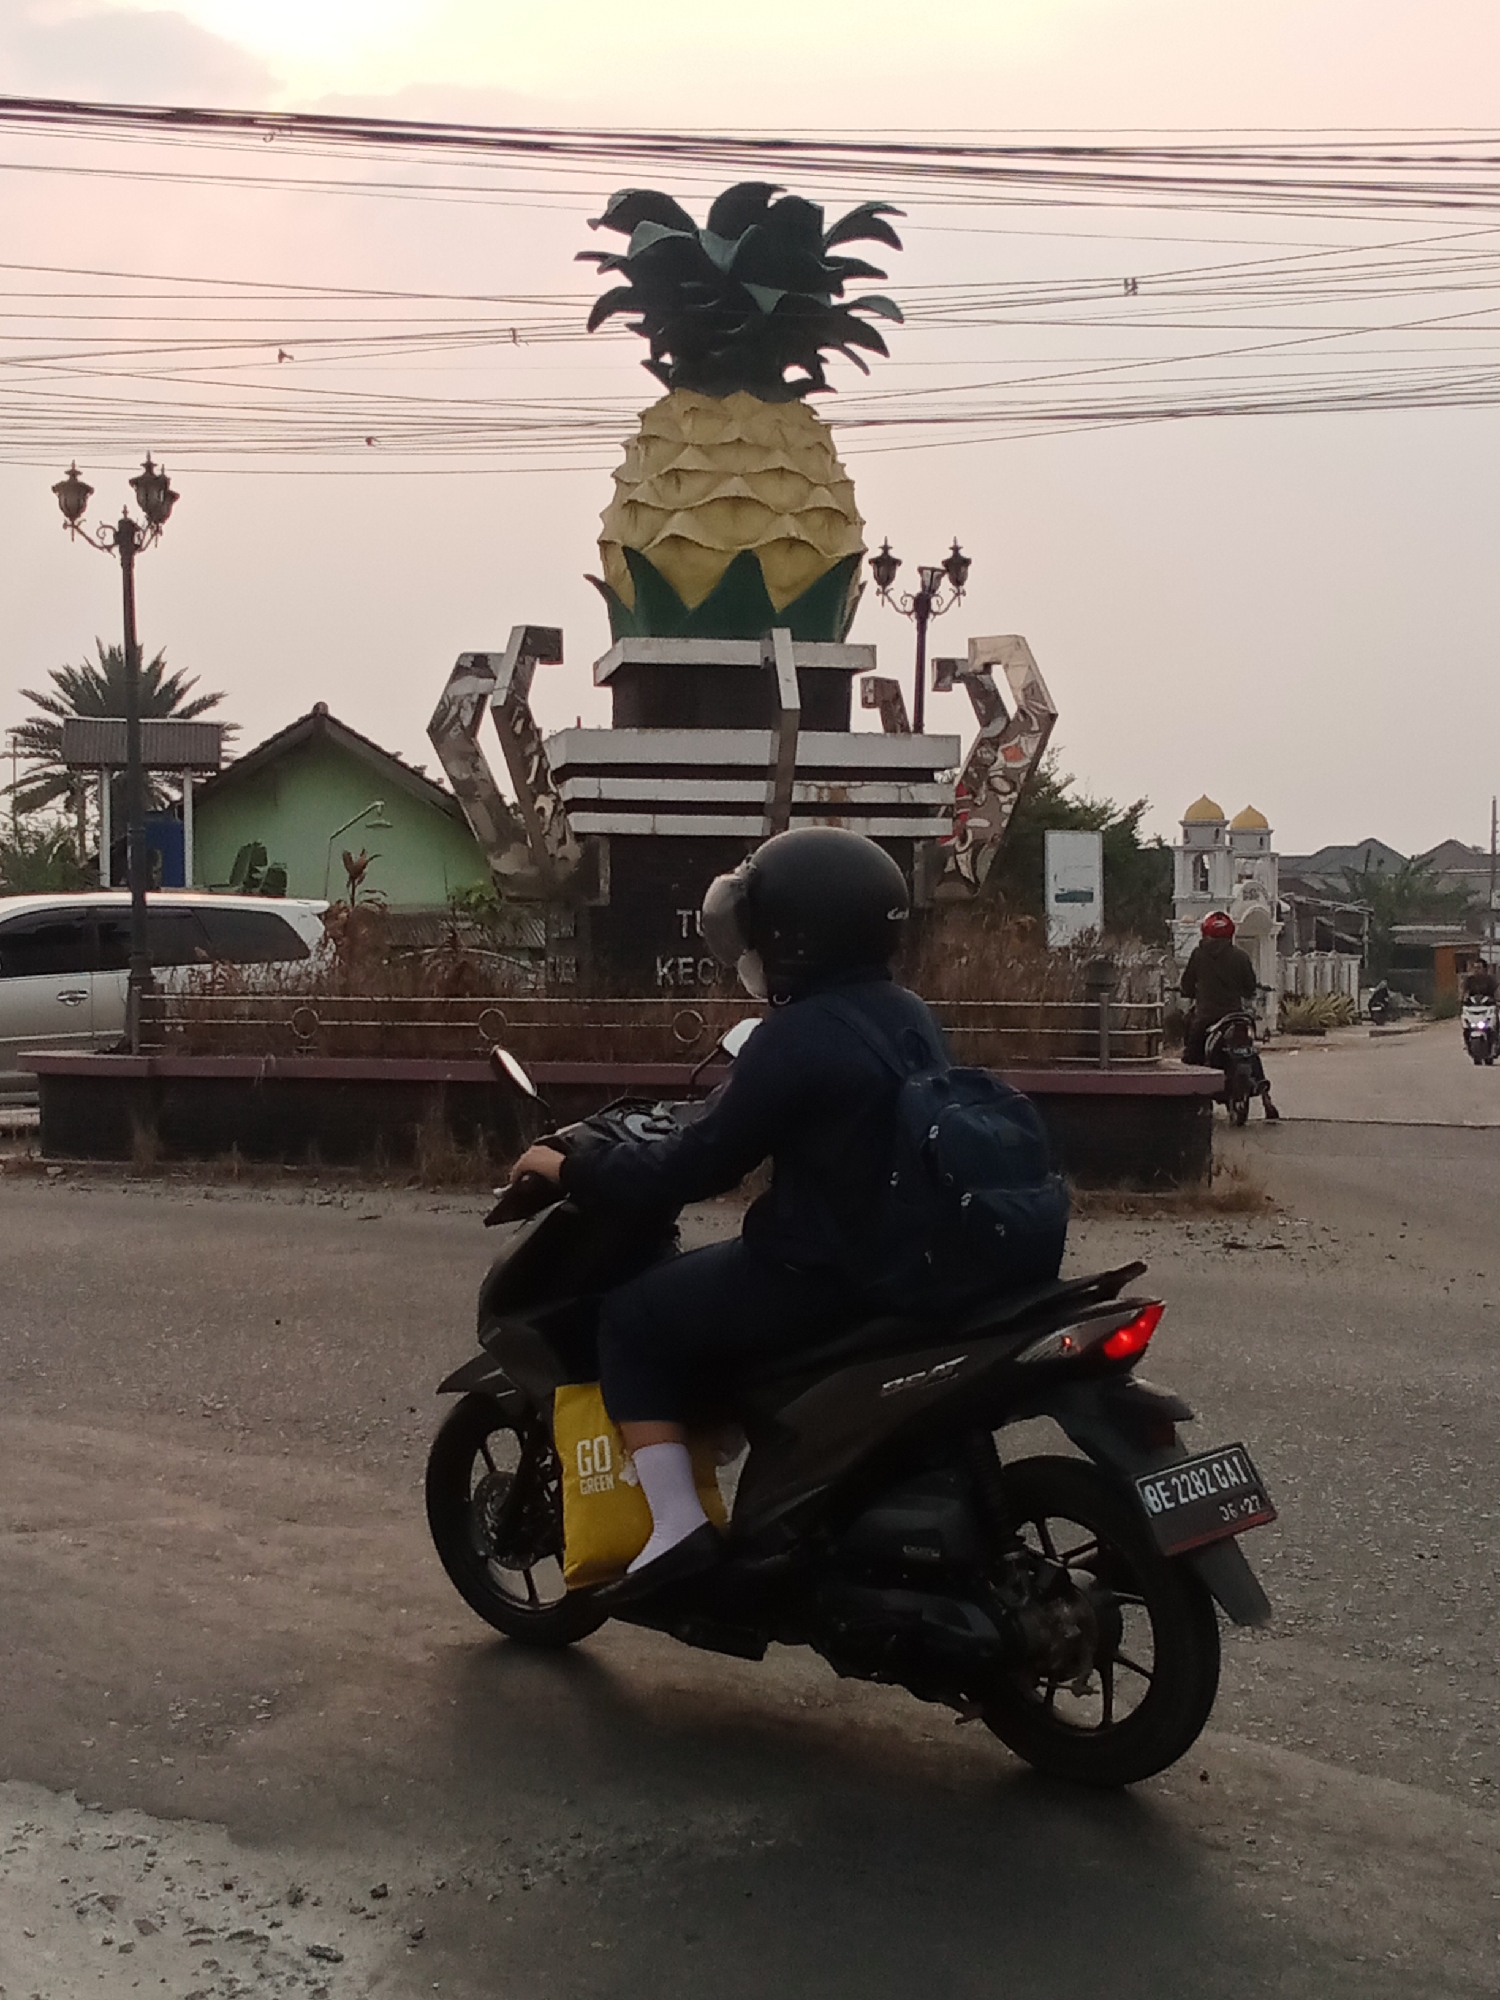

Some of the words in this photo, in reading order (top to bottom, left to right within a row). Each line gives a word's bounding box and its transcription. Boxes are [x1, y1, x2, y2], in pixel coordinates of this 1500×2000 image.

[576, 1435, 612, 1477] GO
[579, 1473, 615, 1495] GREEN
[1144, 1480, 1176, 1514] BE
[1171, 1467, 1219, 1505] 2282
